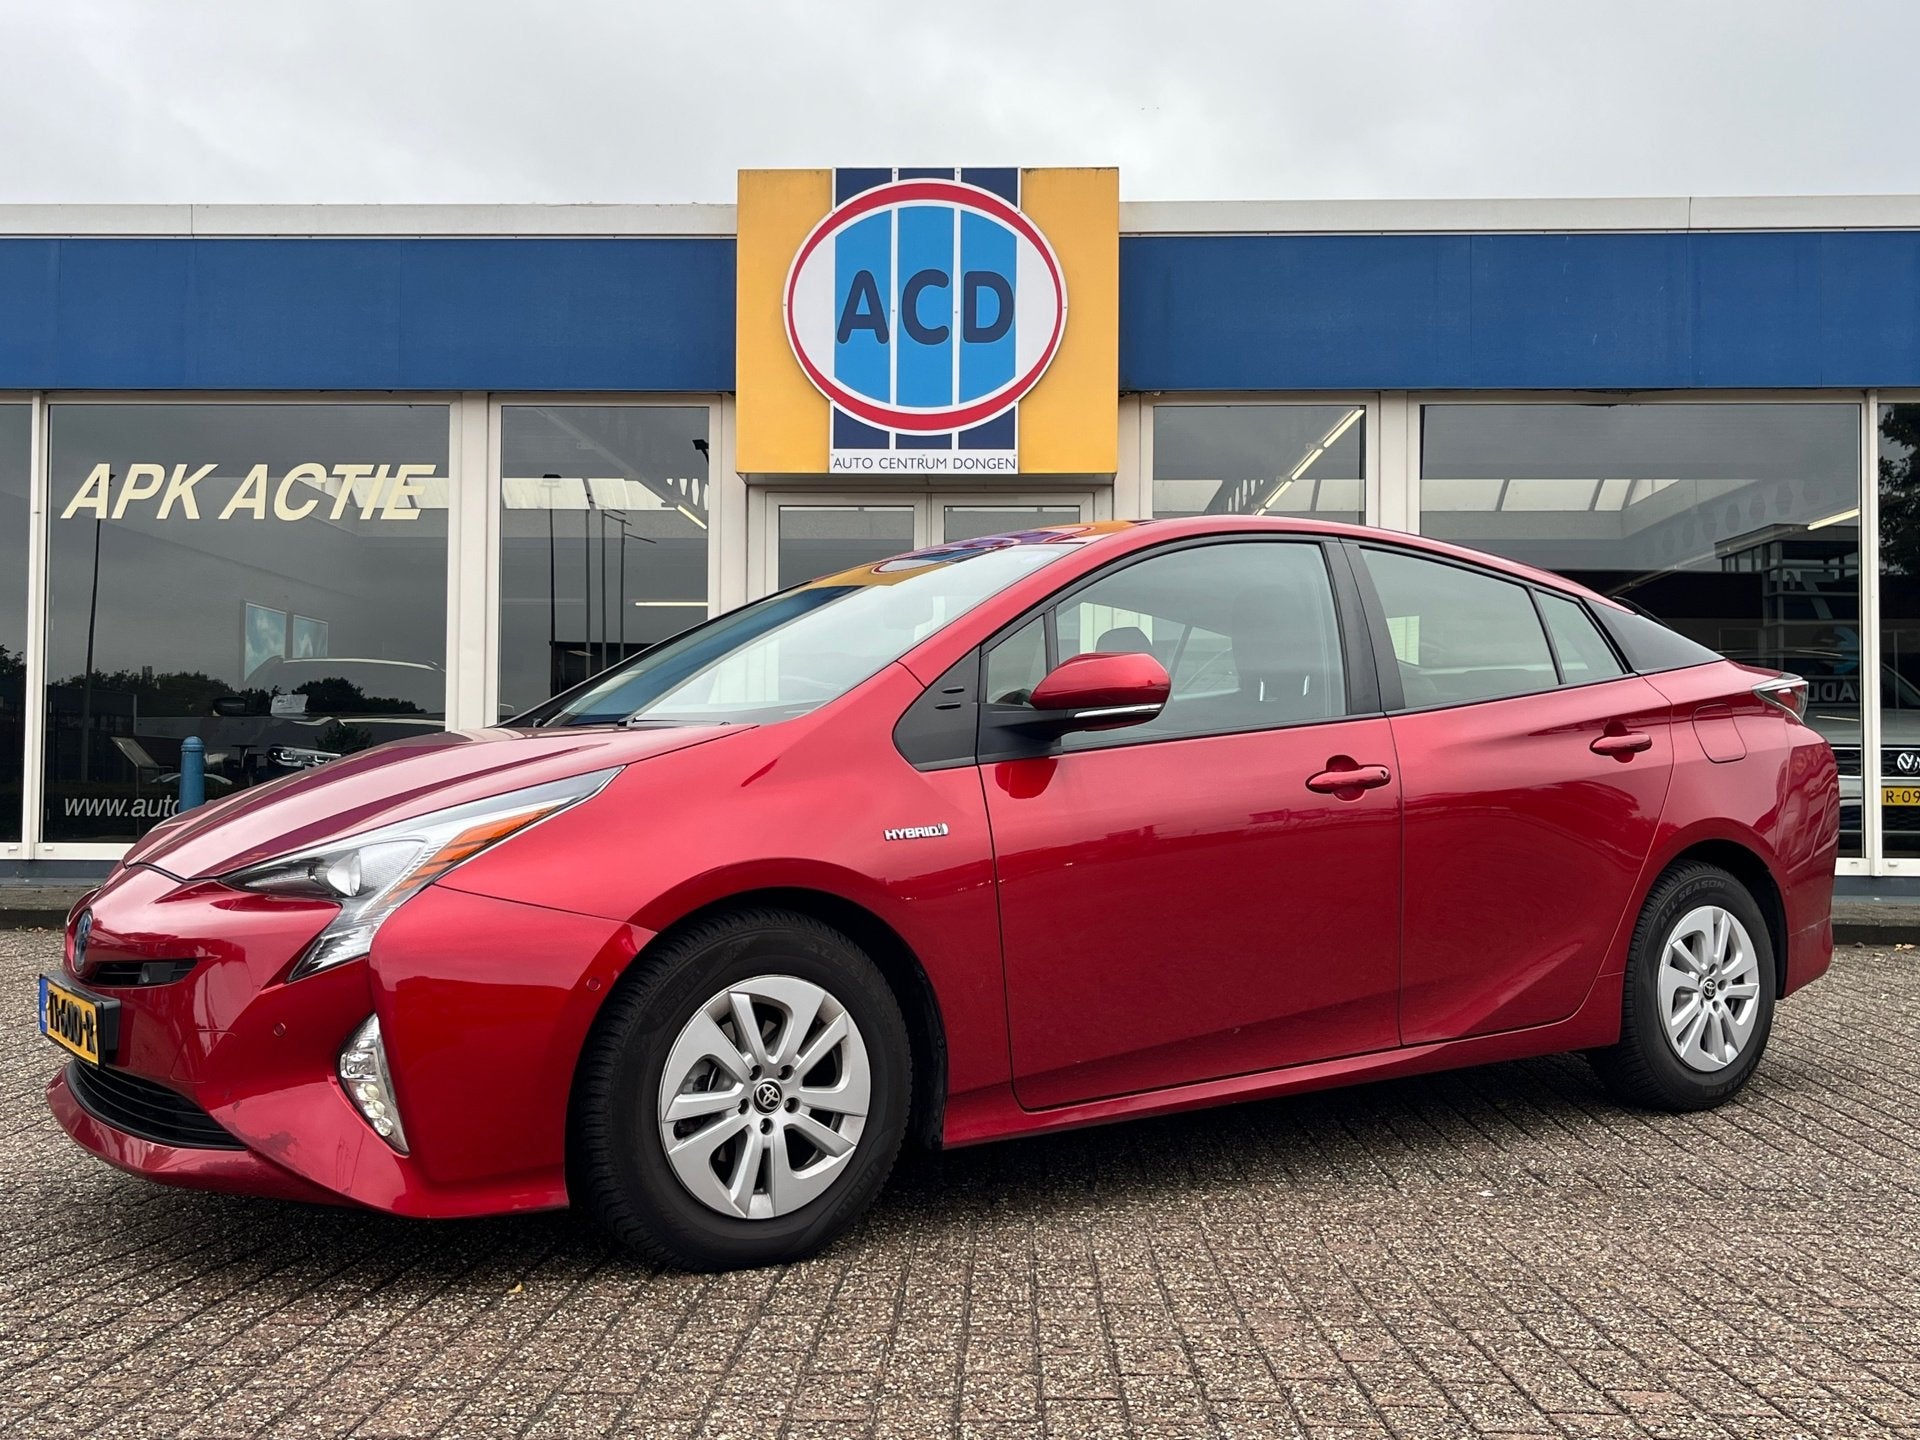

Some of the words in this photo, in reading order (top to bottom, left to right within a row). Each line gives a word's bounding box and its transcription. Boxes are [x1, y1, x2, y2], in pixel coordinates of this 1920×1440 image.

[837, 269, 1015, 345] ACD
[833, 457, 873, 470] AUTO
[879, 457, 947, 470] CENTRUM
[953, 457, 1016, 470] DONGEN
[60, 463, 219, 520] APK
[218, 463, 436, 521] ACTIE
[884, 825, 939, 840] HYBRID
